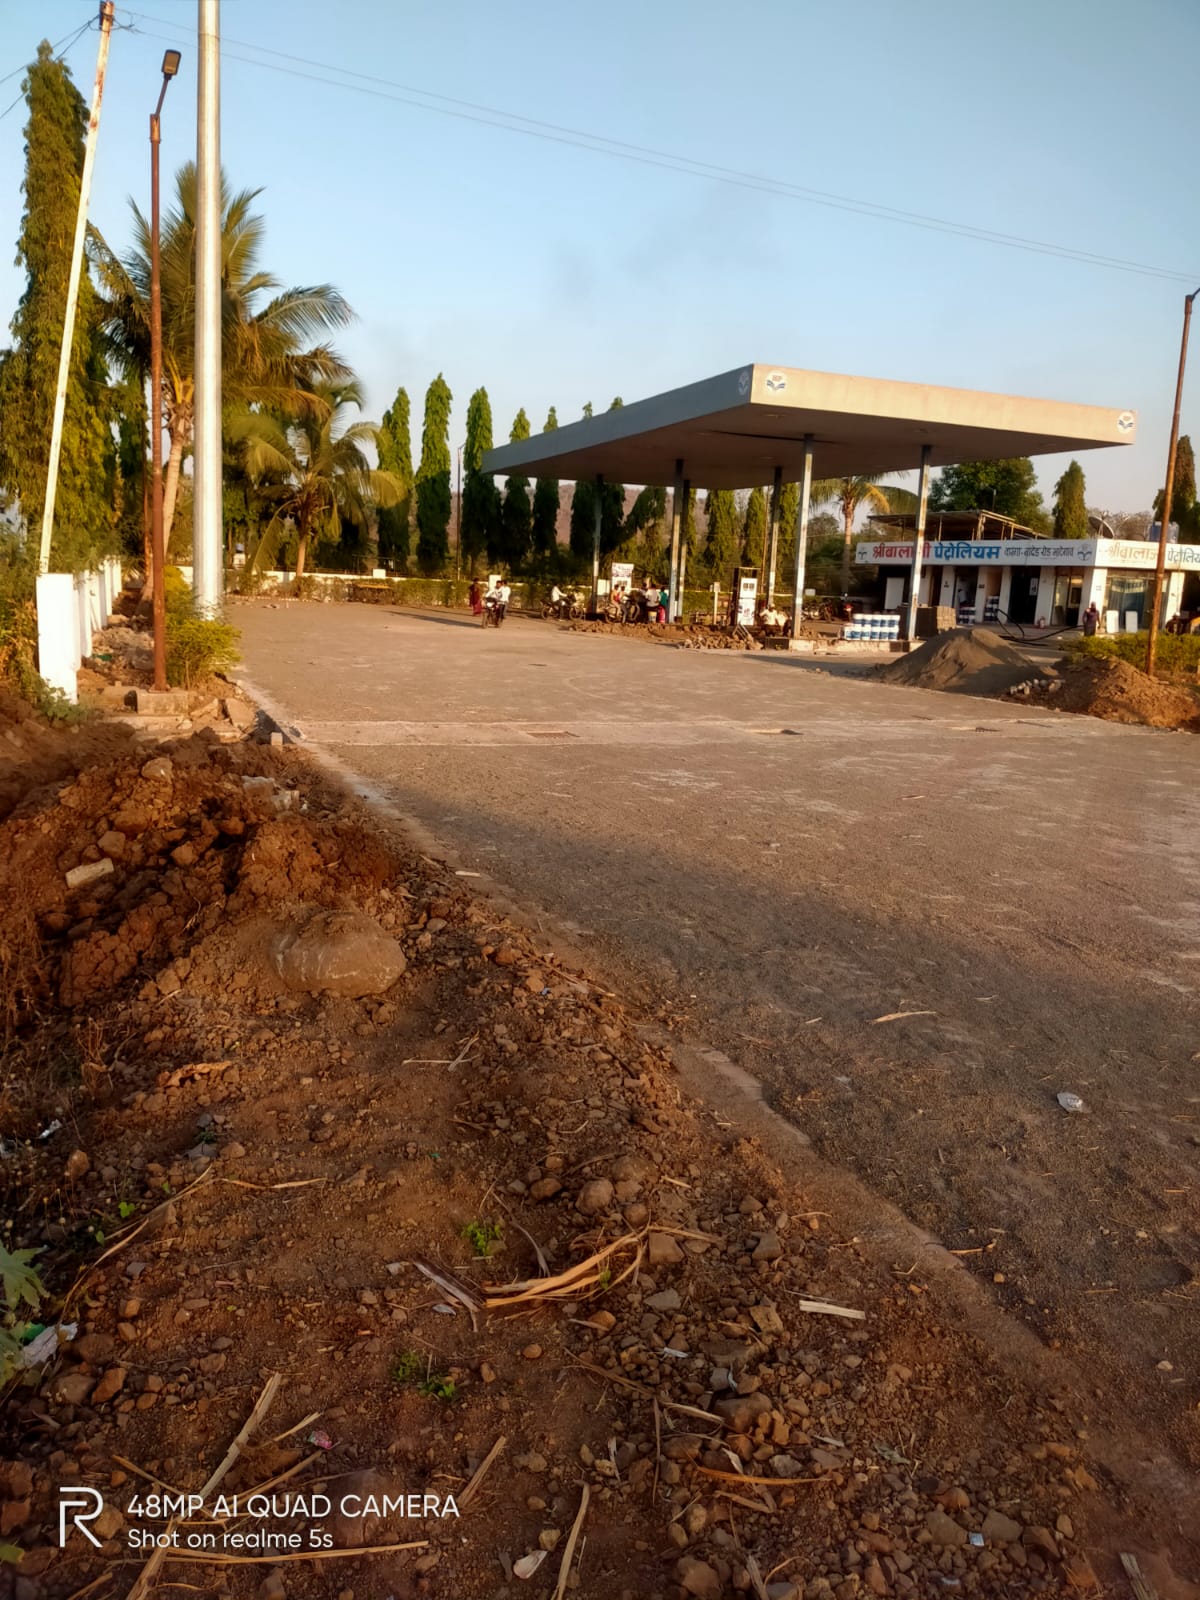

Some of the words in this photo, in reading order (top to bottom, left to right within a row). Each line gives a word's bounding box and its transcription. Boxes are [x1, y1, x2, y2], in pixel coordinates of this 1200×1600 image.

[872, 541, 931, 559] श्रीबालाी
[934, 541, 1001, 560] पेट्रोलियम
[1107, 542, 1157, 561] श्रीबालाज
[1167, 546, 1200, 564] पेट्रोलिय
